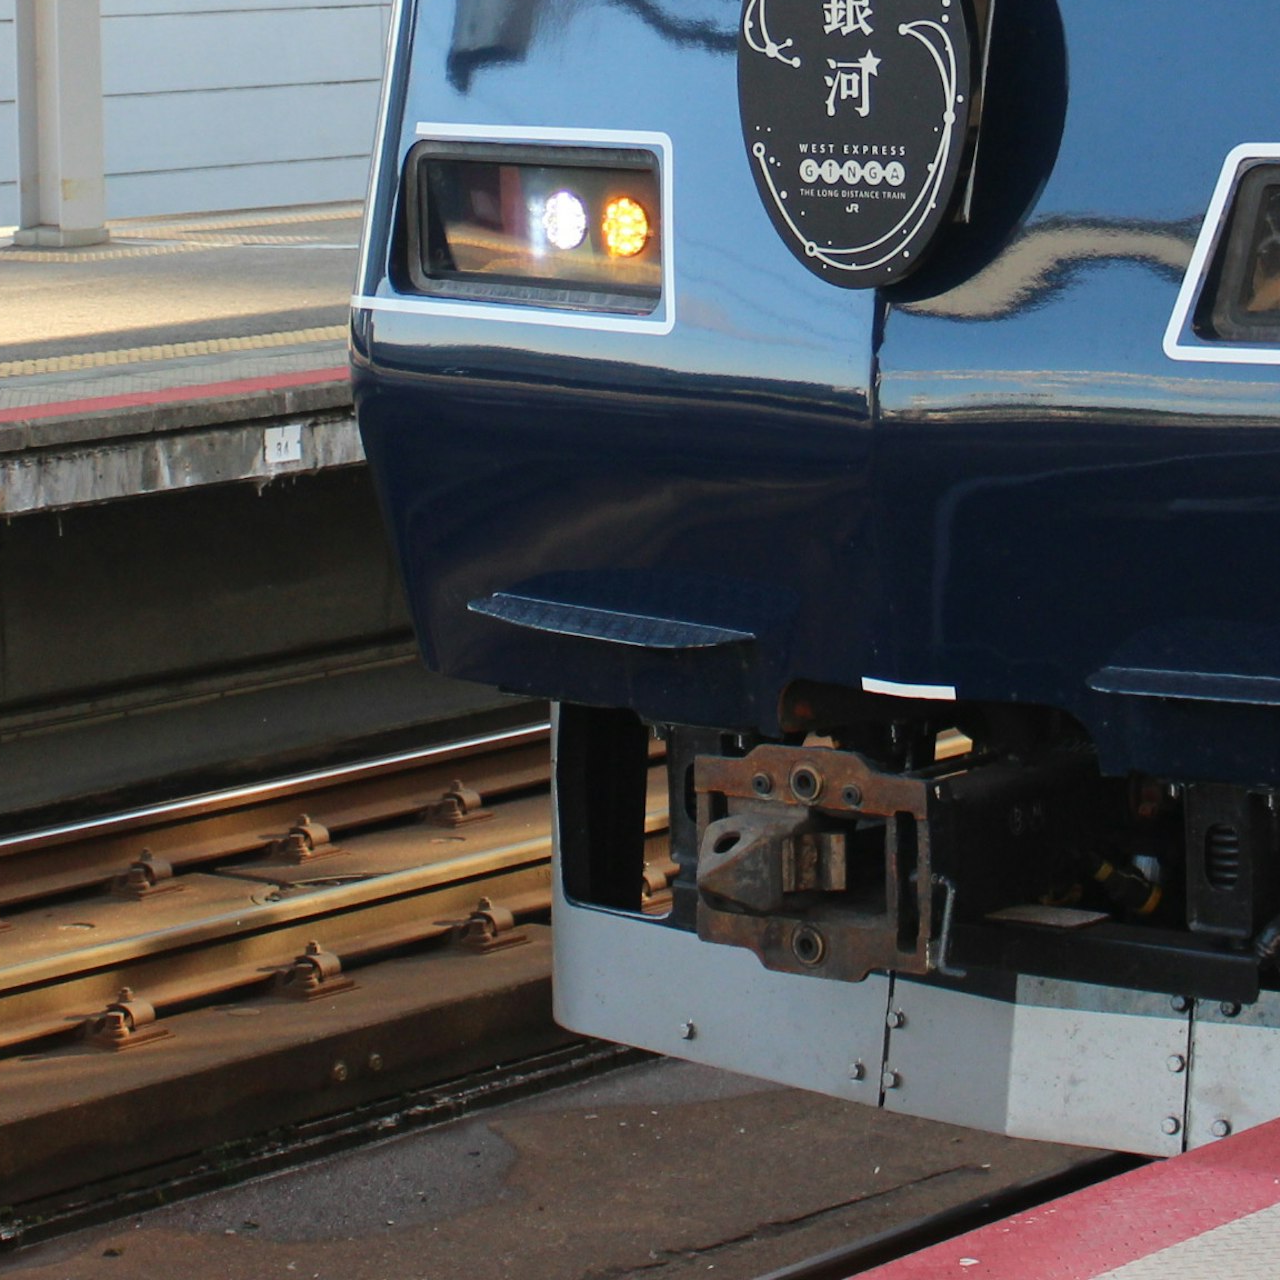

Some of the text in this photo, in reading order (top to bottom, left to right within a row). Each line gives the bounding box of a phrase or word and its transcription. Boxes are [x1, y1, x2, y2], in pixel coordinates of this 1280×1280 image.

[799, 143, 906, 157] WEST EXPRESS
[799, 188, 907, 201] THE LONG DISTANCE TRAIN
[845, 202, 860, 214] JR
